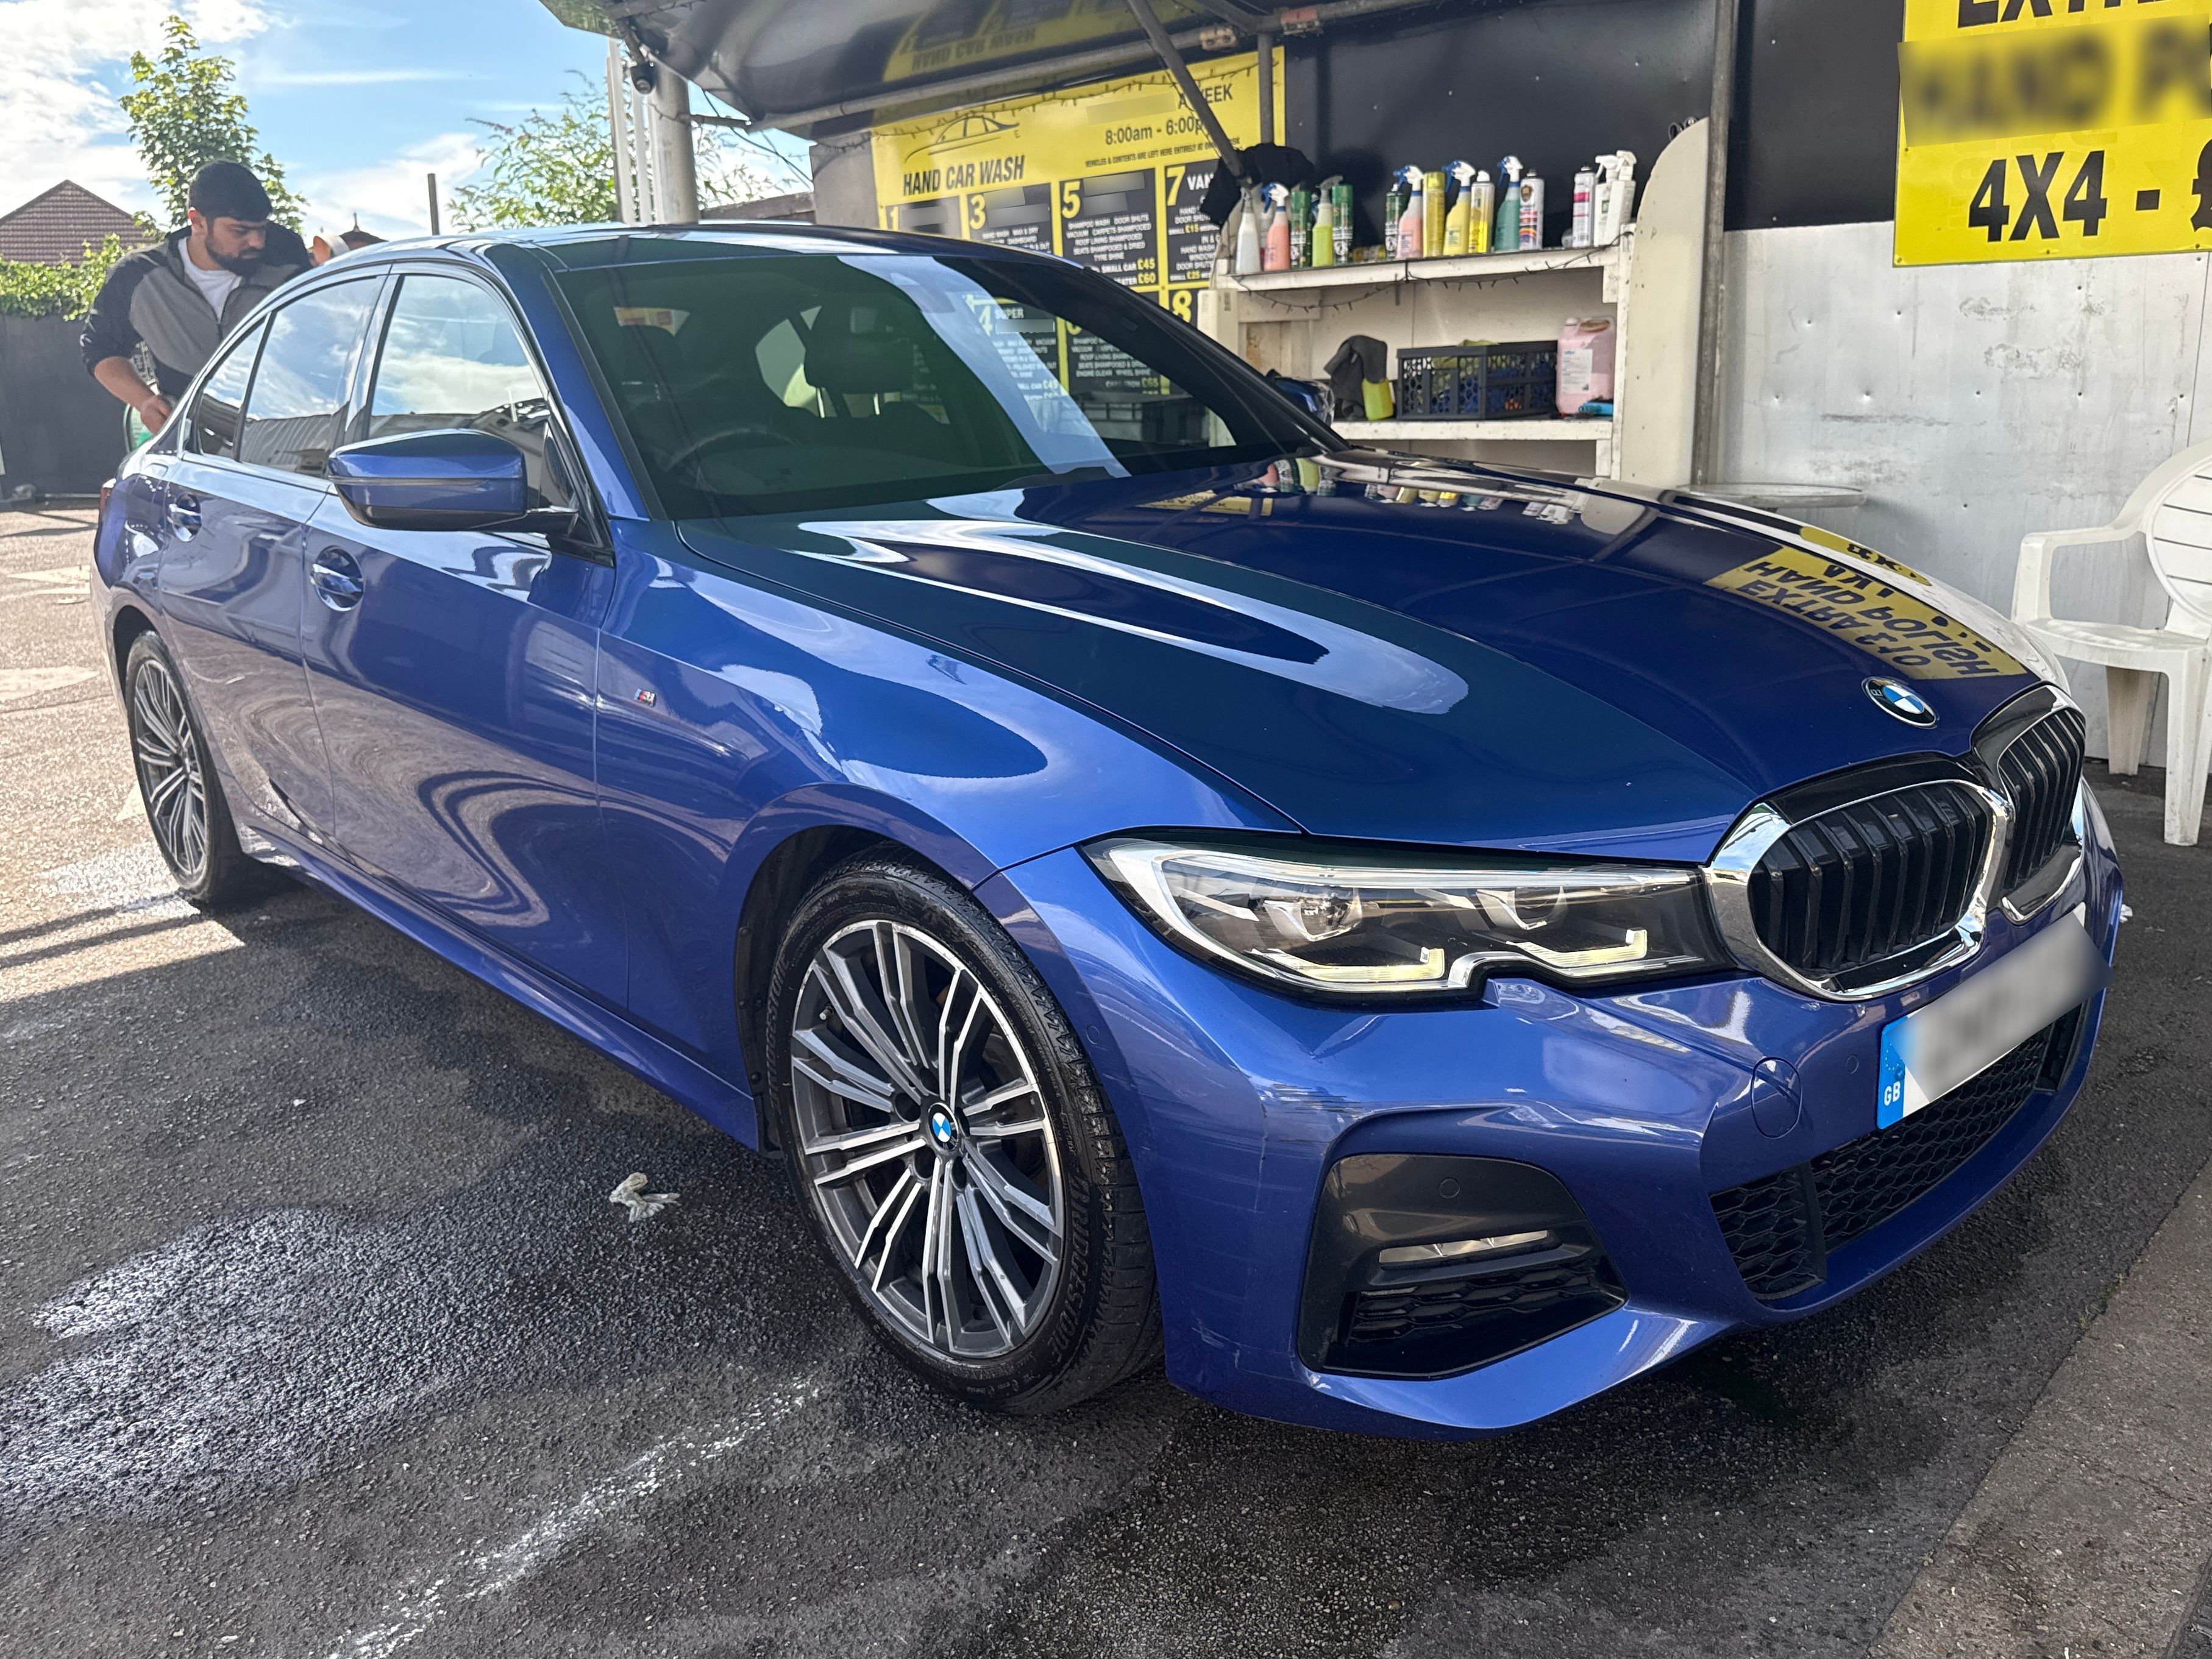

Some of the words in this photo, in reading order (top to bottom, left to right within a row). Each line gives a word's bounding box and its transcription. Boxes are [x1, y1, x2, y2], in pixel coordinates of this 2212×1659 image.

[1201, 83, 1233, 104] EEK
[1105, 126, 1152, 145] 8:00am
[1166, 116, 1203, 135] 6:00p
[903, 169, 941, 196] HAND
[947, 163, 975, 190] CAR
[980, 155, 1025, 185] WASH
[1167, 166, 1186, 206] 7
[1062, 180, 1081, 218] 5
[1968, 150, 2108, 243] 4X4
[890, 207, 898, 231] 1
[970, 195, 986, 229] 3
[1101, 263, 1122, 274] SMALL
[1123, 262, 1137, 272] CAR
[1137, 257, 1156, 270] £45
[1137, 272, 1156, 284] £60
[994, 308, 1024, 319] SUPER
[1883, 1081, 1901, 1106] GB
